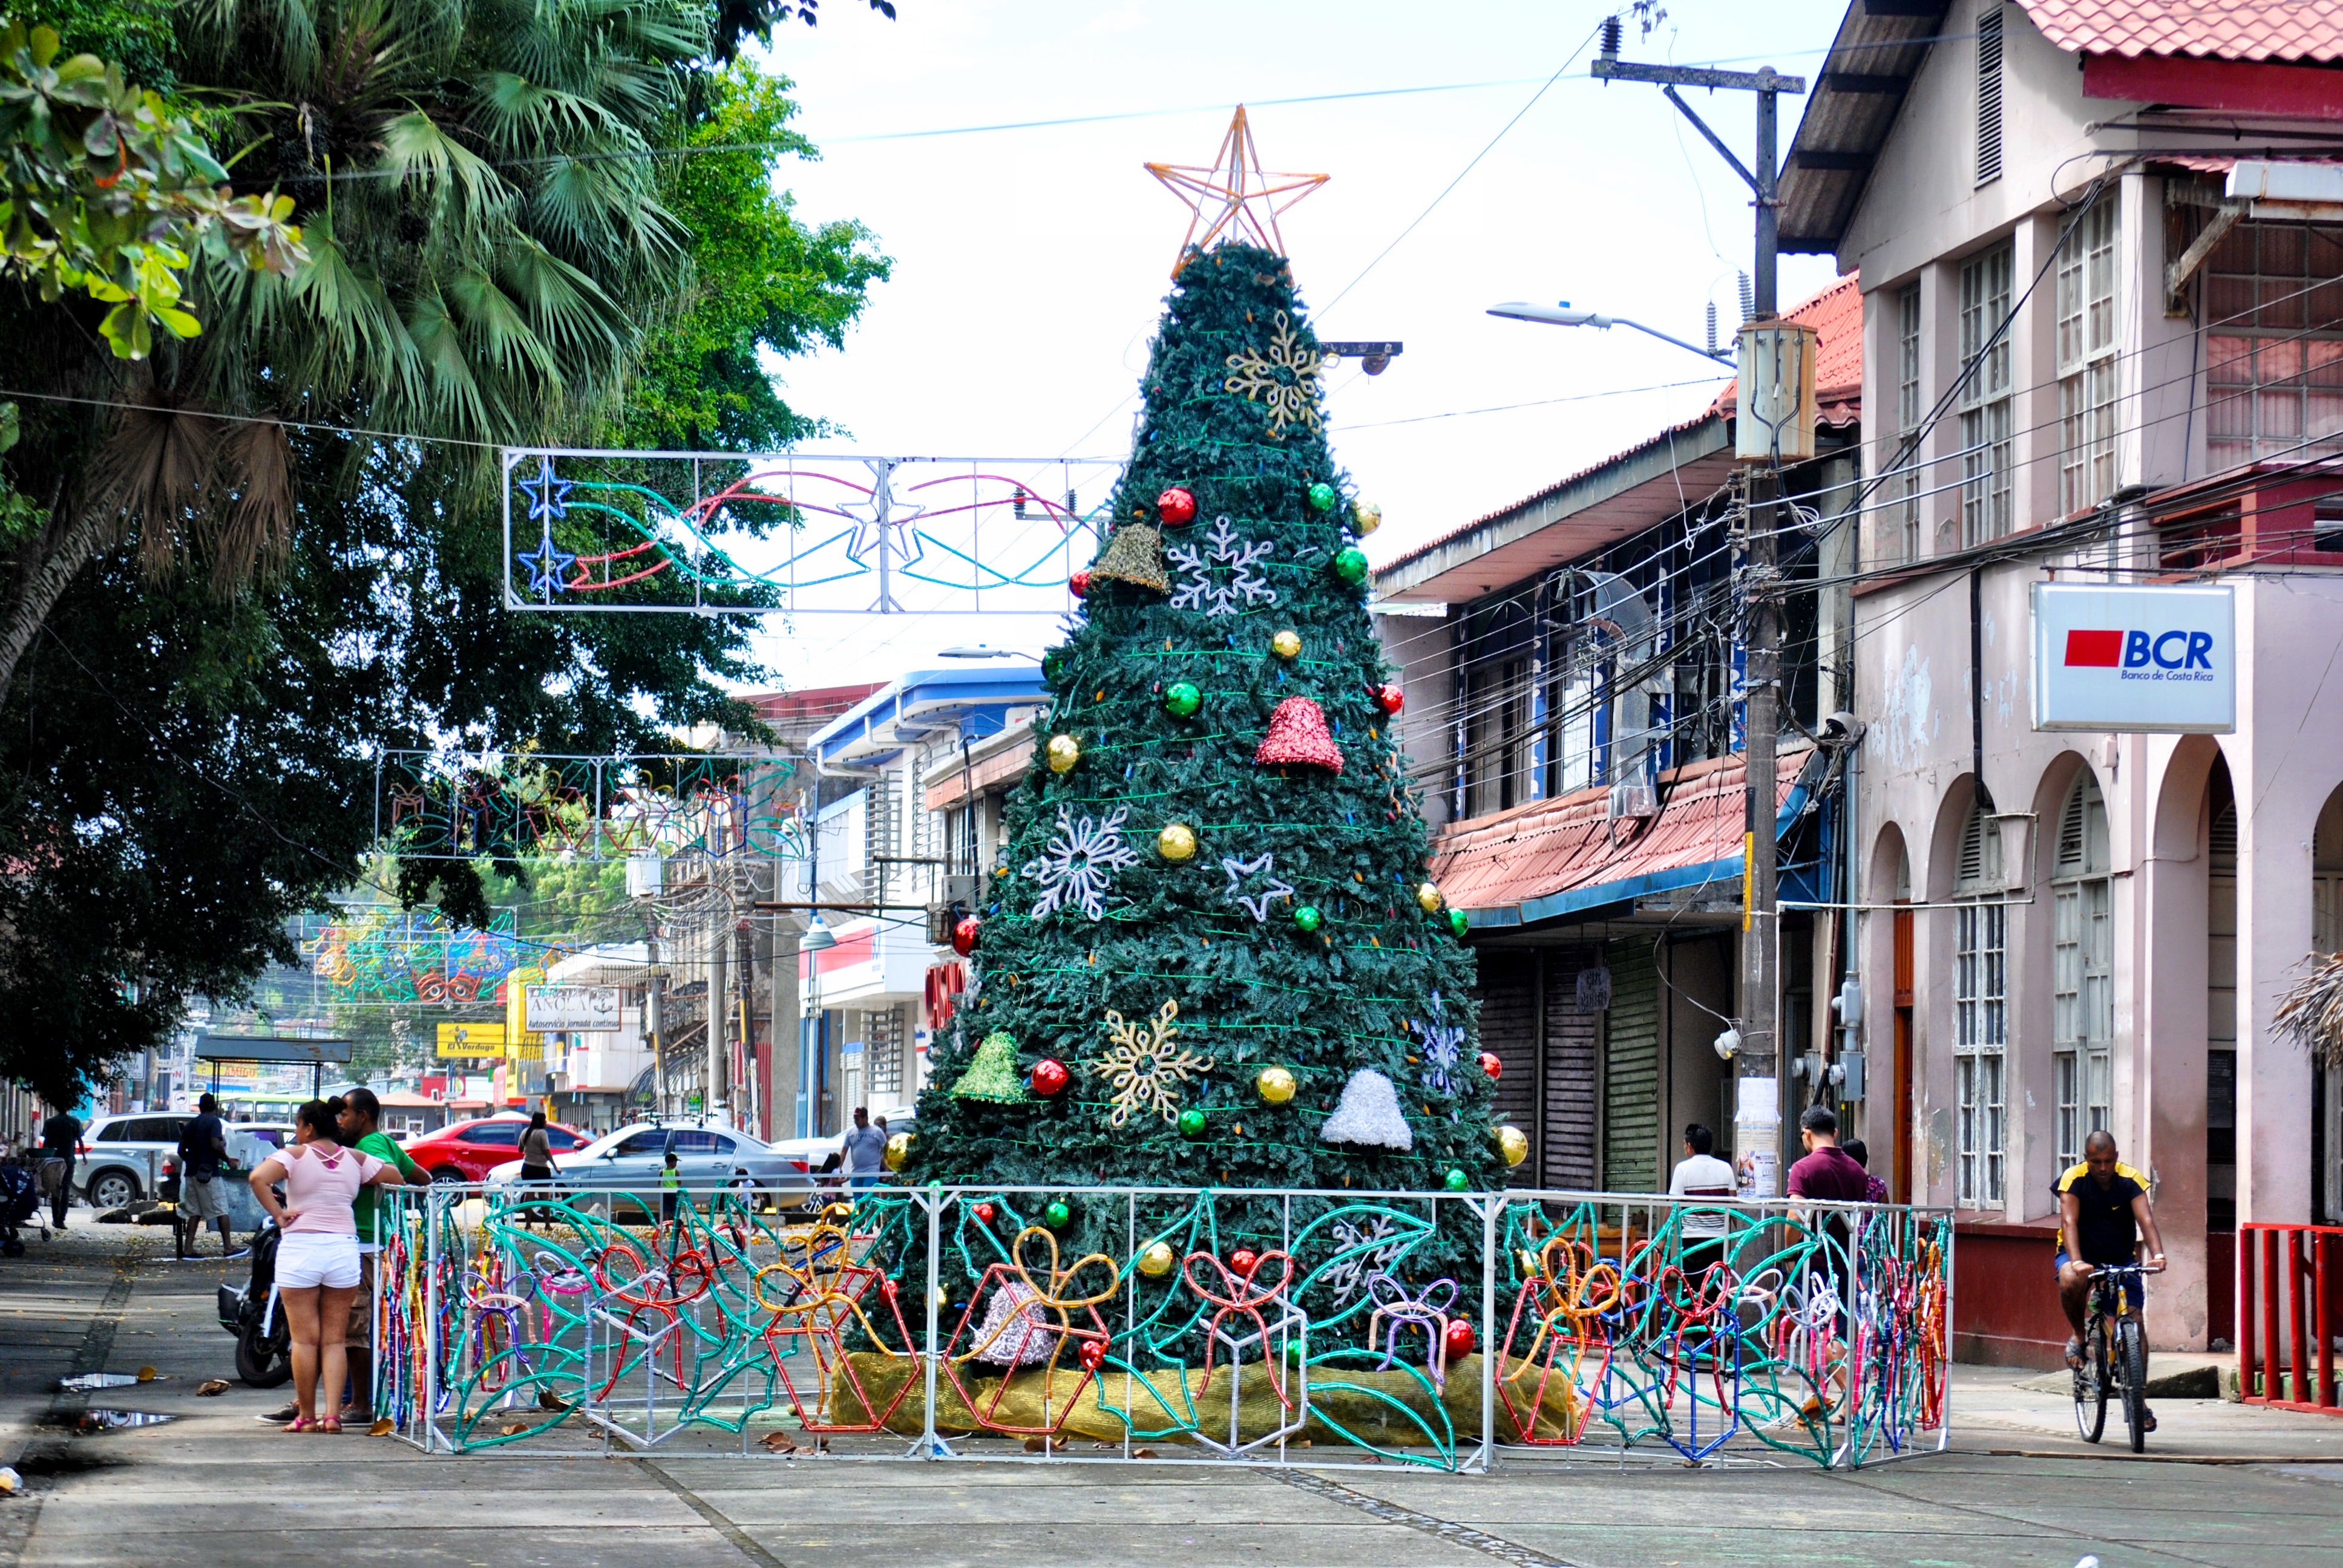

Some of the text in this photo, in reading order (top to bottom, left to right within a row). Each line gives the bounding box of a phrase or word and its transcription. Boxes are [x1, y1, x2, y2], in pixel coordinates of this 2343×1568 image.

[2123, 630, 2213, 669] BCR
[2121, 670, 2214, 681] Banco de Costa Rica
[528, 1019, 619, 1028] Autoservicio jornada continua
[224, 1067, 255, 1077] AMIGO
